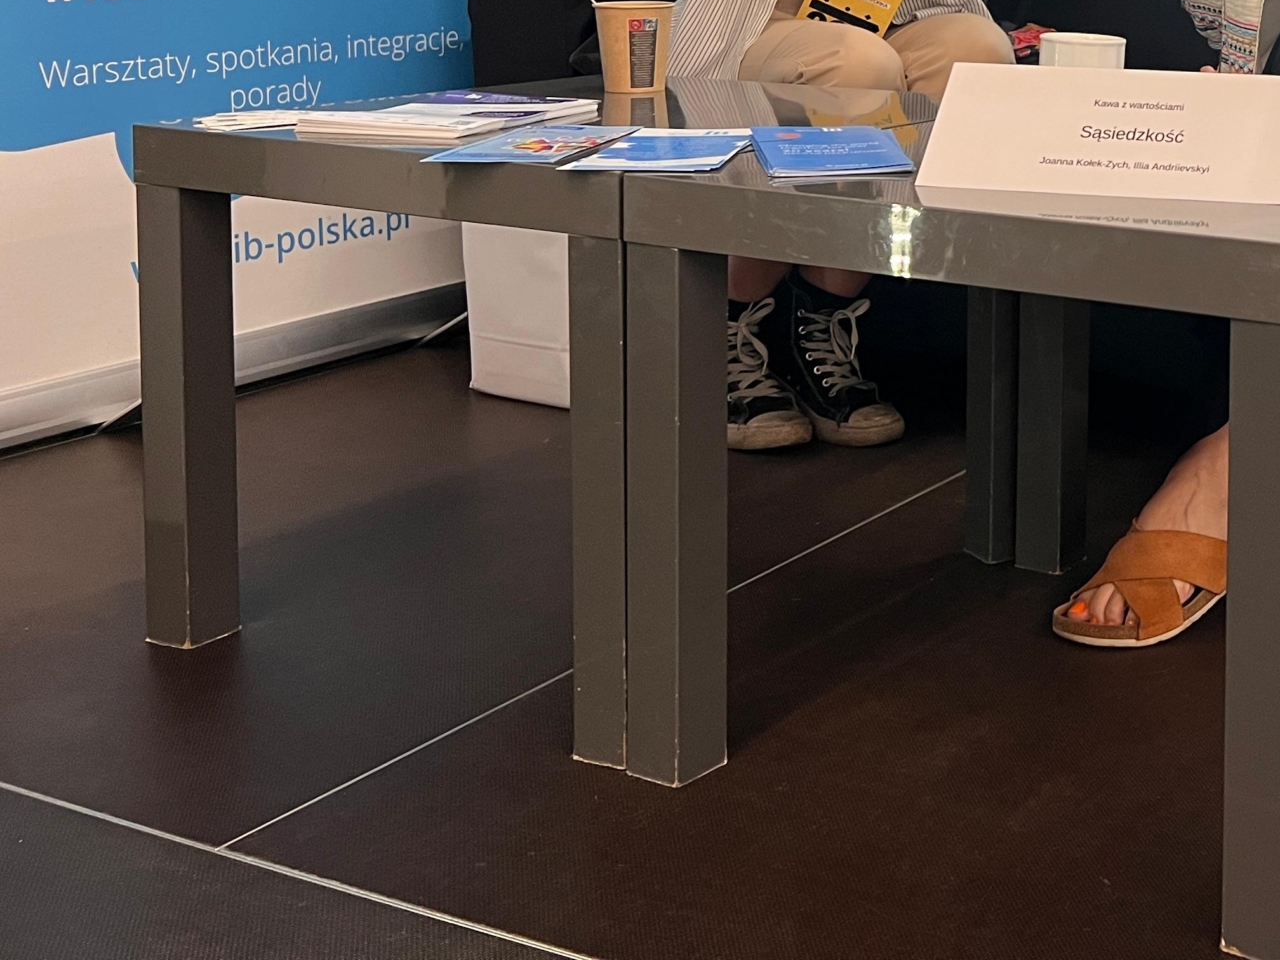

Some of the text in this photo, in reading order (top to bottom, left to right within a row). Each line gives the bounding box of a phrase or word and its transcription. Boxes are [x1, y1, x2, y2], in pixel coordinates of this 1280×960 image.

[38, 27, 465, 90] Warsztaty, spotkania, integracje,
[230, 76, 322, 112] porady
[1093, 99, 1186, 112] Kawa z wartościami
[1080, 125, 1186, 144] Sąsiedzkość
[1039, 156, 1074, 167] Joanna
